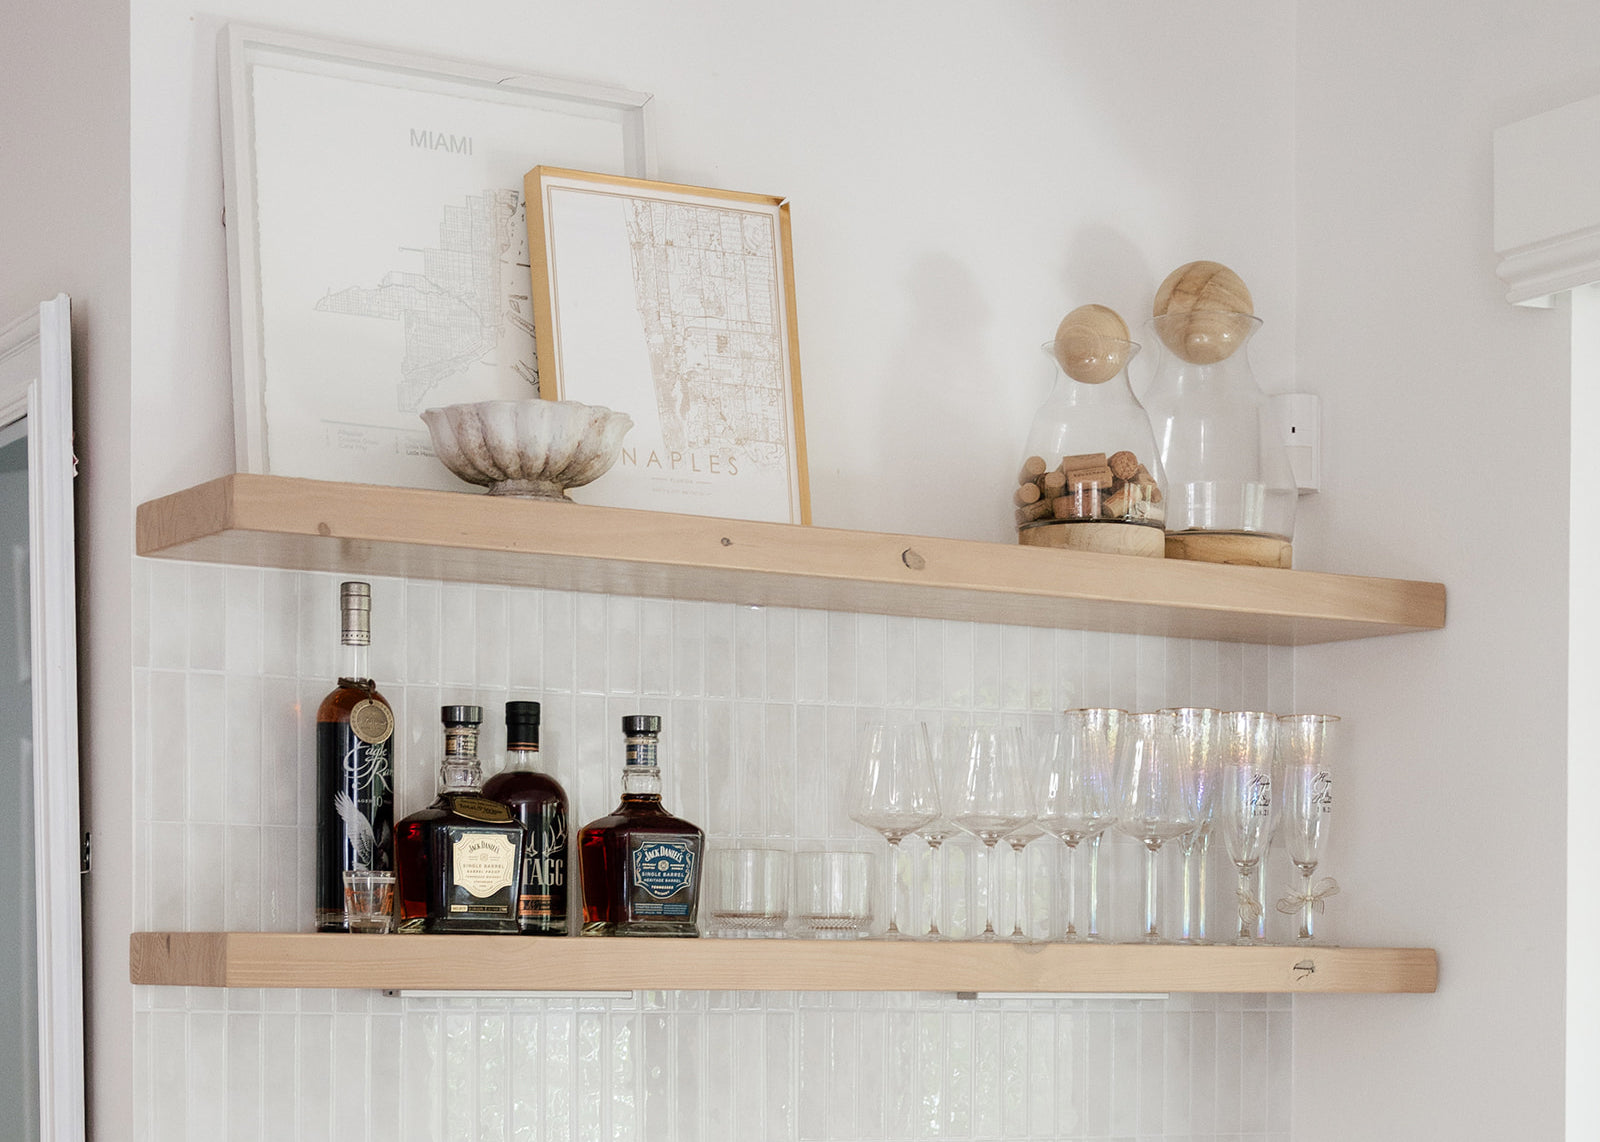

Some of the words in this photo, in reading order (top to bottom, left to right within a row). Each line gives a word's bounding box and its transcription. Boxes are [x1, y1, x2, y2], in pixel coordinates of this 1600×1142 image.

[410, 128, 472, 156] MIAMI
[622, 447, 738, 475] NAPLES
[468, 843, 481, 854] JACK
[644, 848, 660, 862] JACK
[660, 846, 684, 863] DANIEL'S
[522, 858, 563, 886] TAGG
